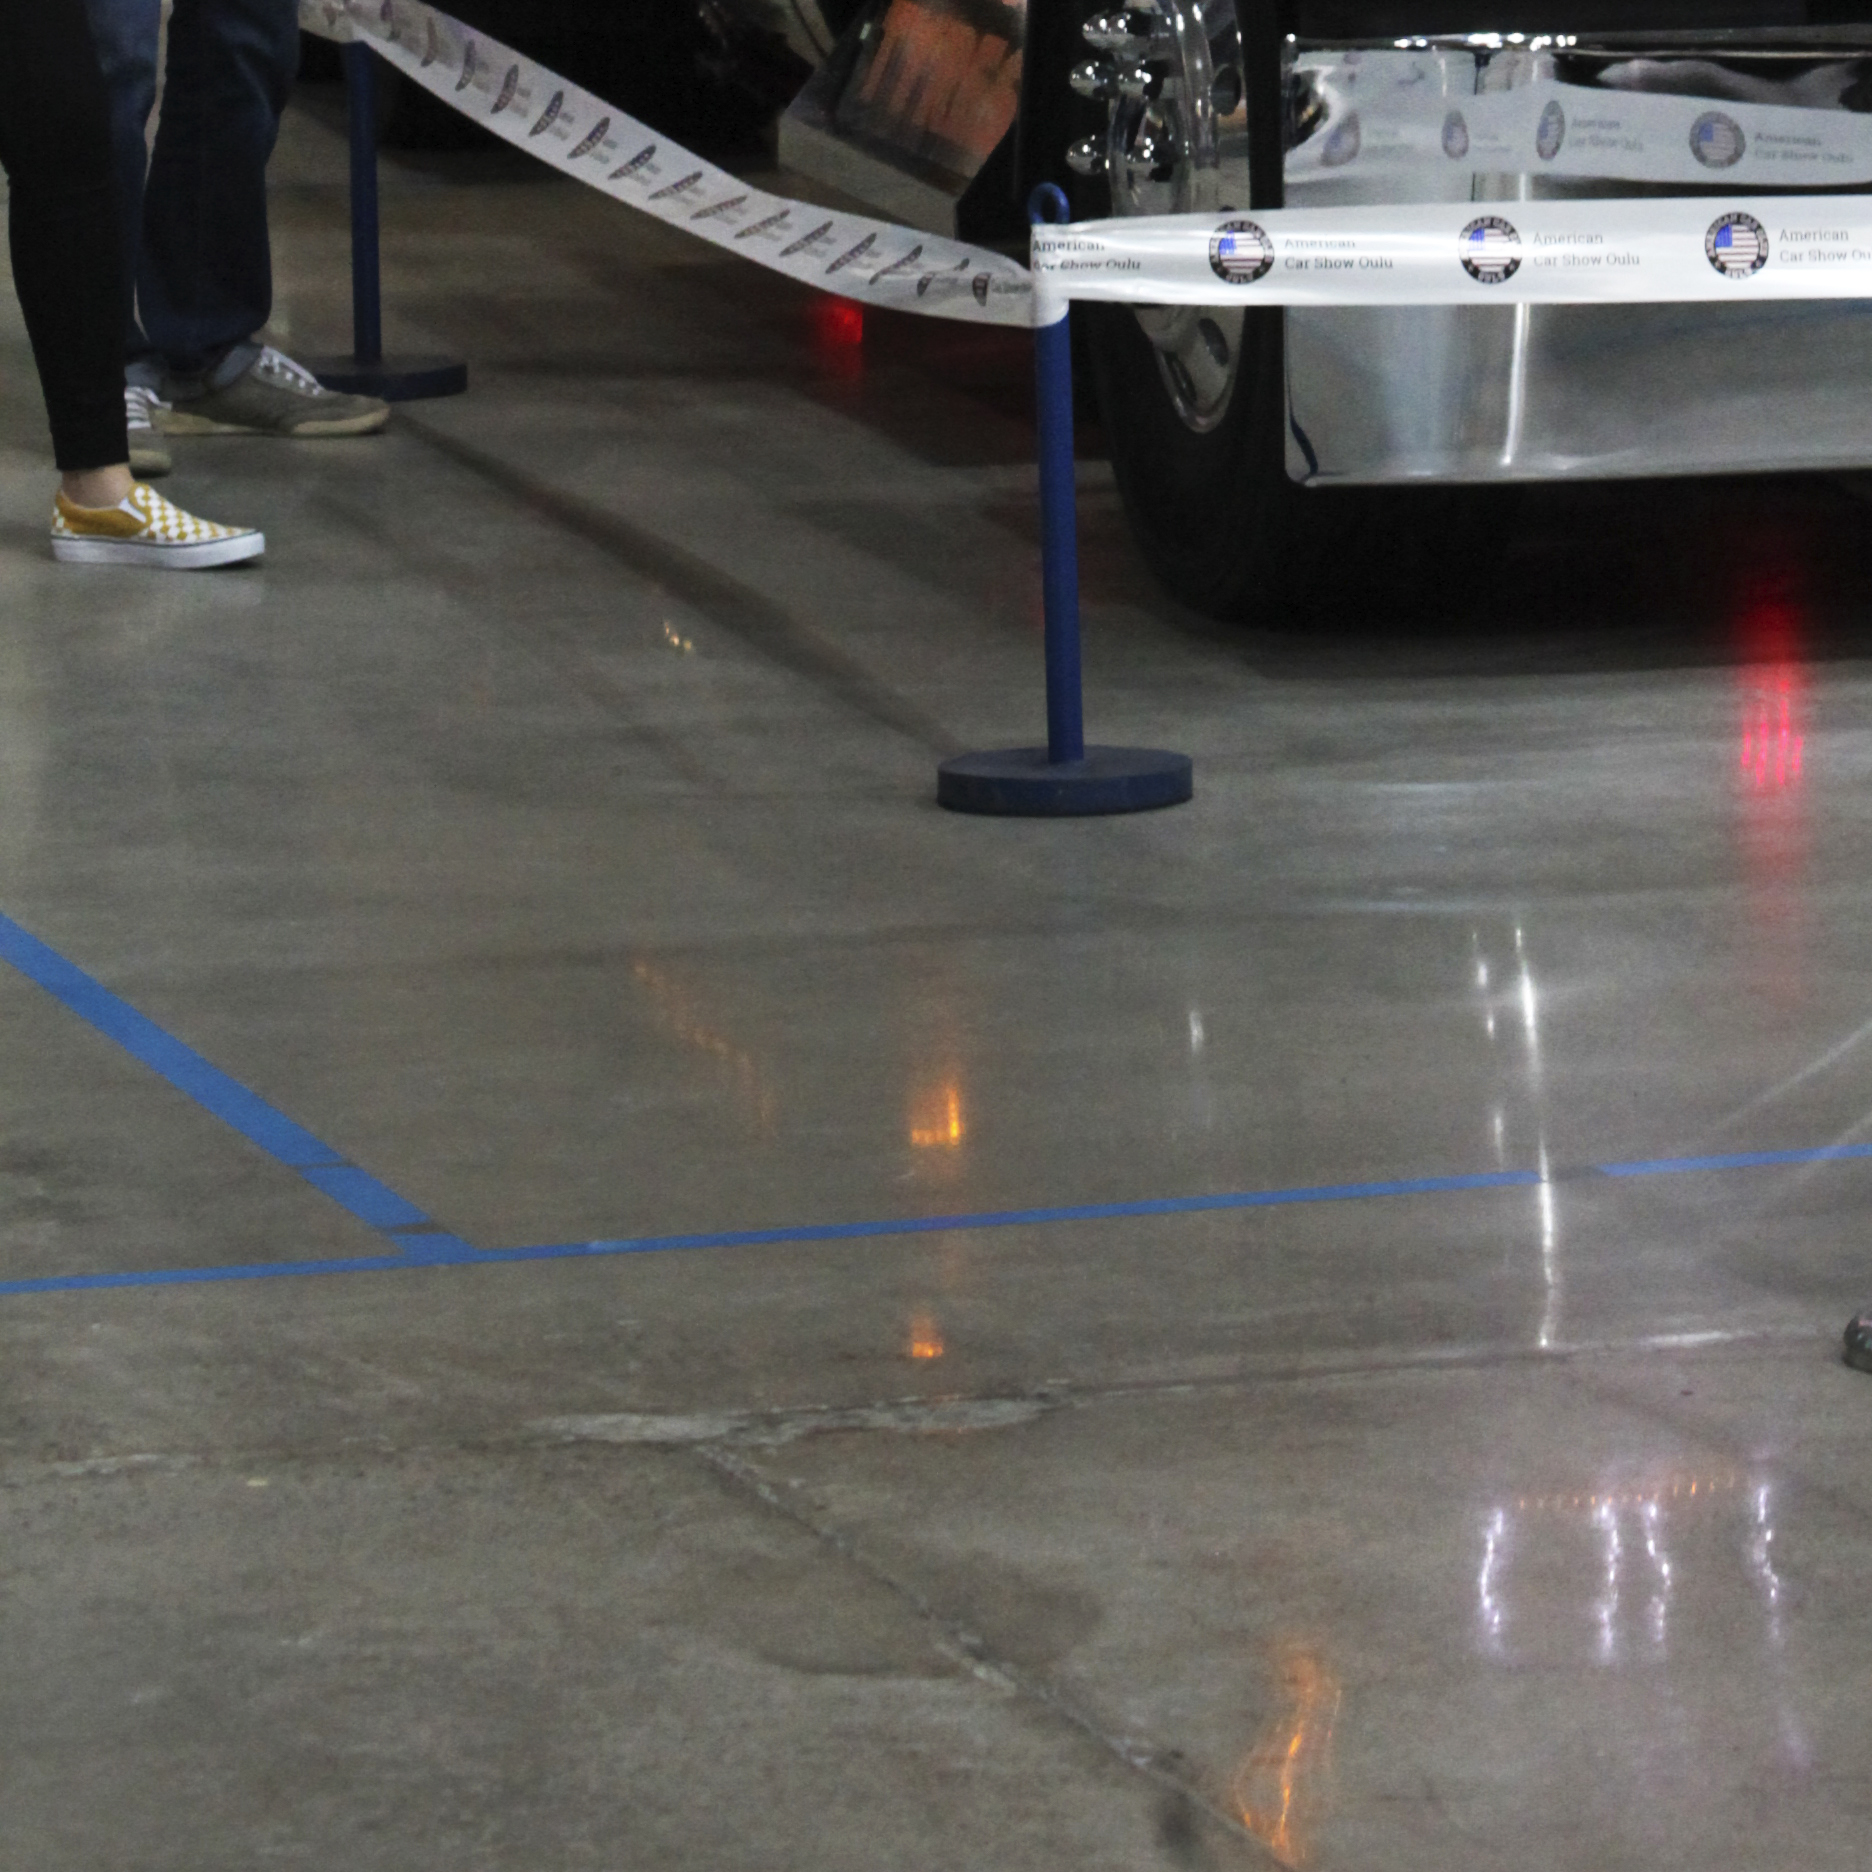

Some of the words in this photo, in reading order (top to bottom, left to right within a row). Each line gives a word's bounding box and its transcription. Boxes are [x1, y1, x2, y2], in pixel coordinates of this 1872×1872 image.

[1533, 231, 1604, 245] American
[1779, 228, 1849, 242] American
[1284, 257, 1310, 270] Car
[1314, 256, 1355, 270] Show
[1359, 256, 1394, 269] Oulu
[1533, 255, 1558, 267] Car
[1562, 253, 1603, 266] Show
[1606, 253, 1641, 266] Oulu
[1780, 250, 1805, 263] Car
[1808, 249, 1848, 262] Show
[1105, 258, 1142, 271] Oulu
